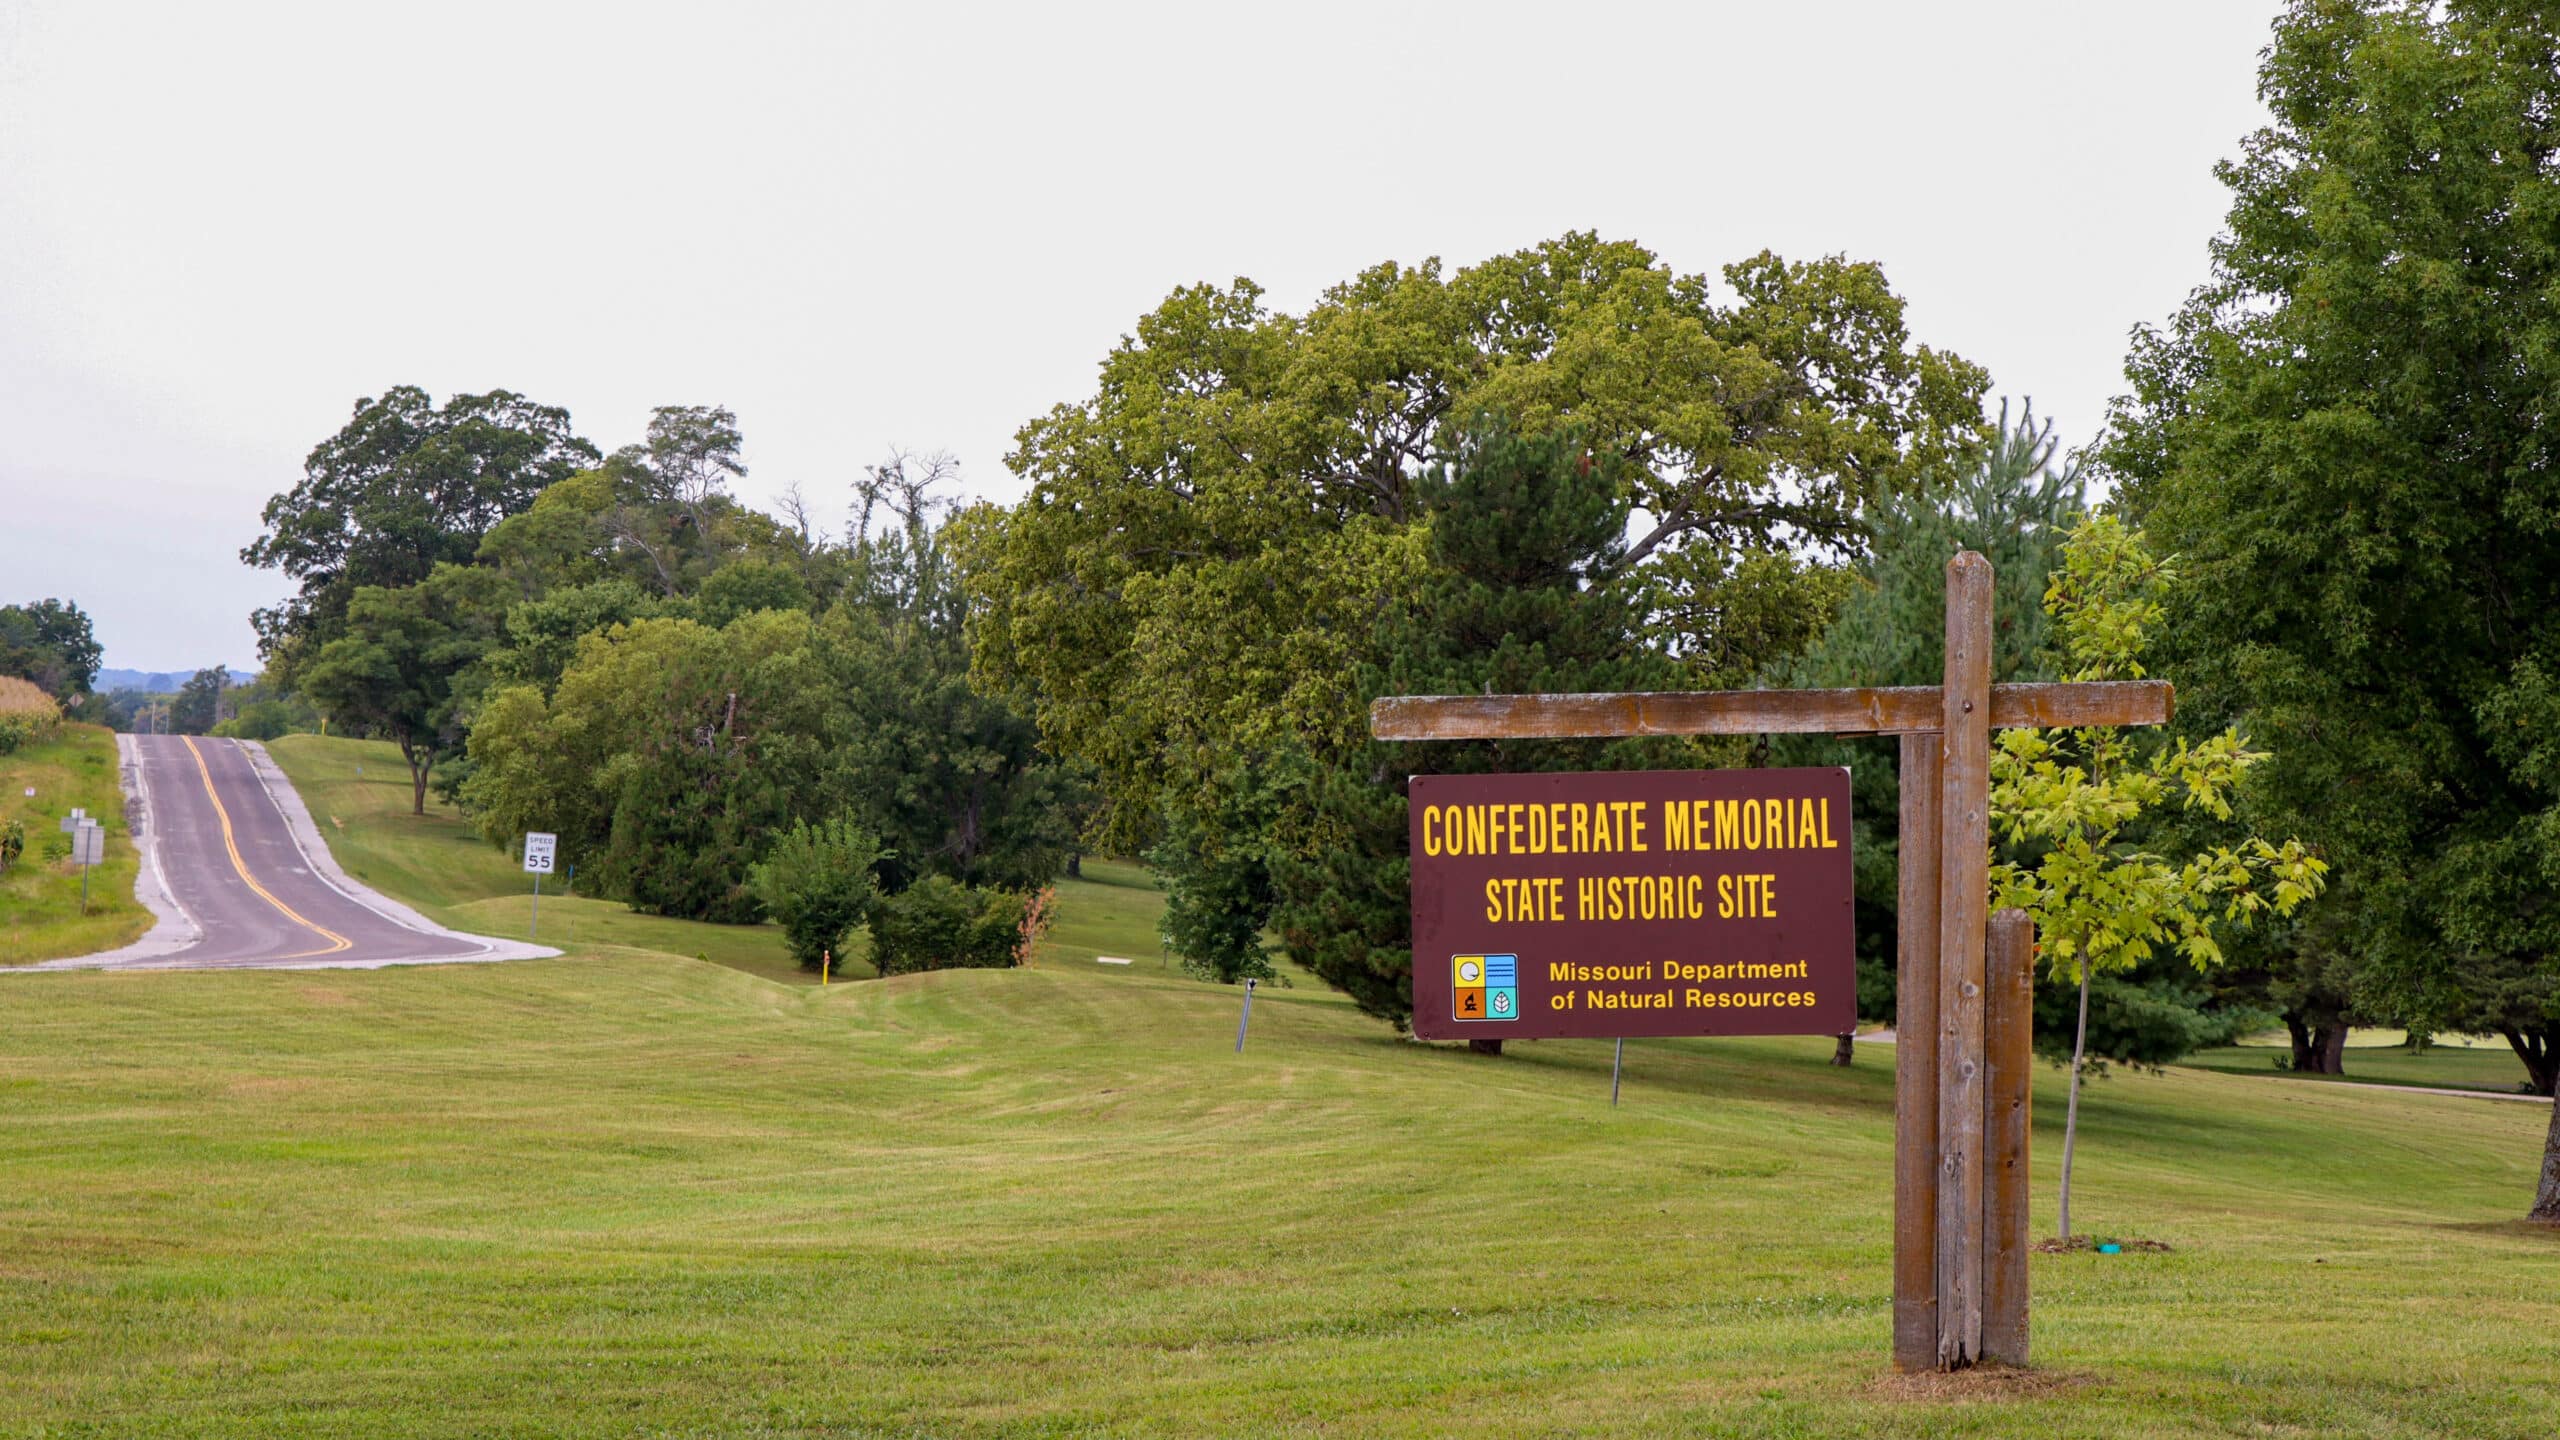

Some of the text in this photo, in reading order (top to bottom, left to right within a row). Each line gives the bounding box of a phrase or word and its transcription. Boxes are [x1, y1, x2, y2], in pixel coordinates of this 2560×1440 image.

[1423, 798, 1838, 856] CONFEDERATE MEMORIAL
[530, 837, 553, 845] SPEED
[528, 855, 550, 869] 55
[1485, 873, 1777, 922] STATE HISTORIC SITE
[1549, 960, 1808, 984] Missouri Department
[1550, 988, 1816, 1010] of Natural Resources
